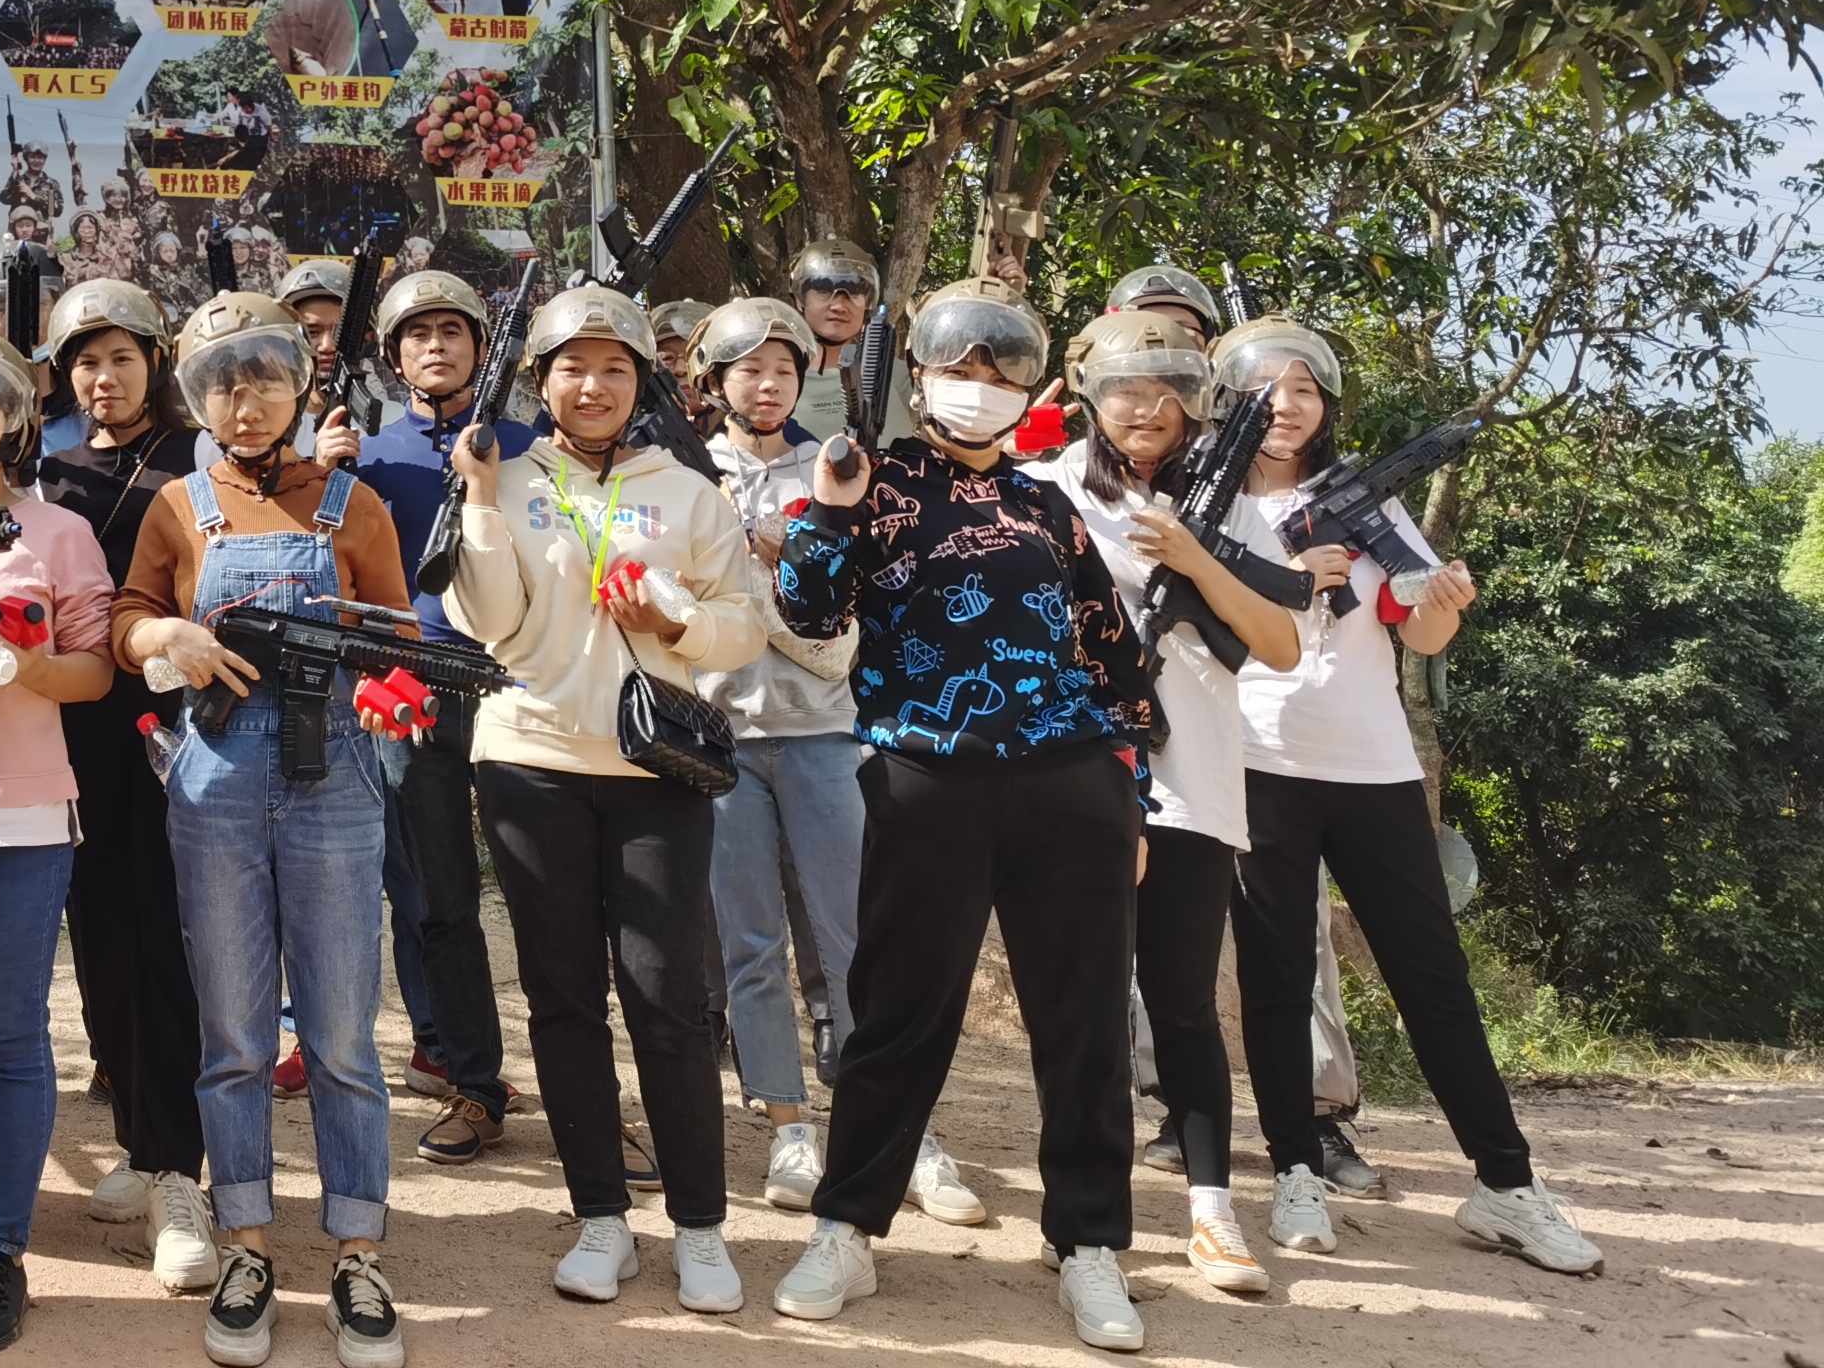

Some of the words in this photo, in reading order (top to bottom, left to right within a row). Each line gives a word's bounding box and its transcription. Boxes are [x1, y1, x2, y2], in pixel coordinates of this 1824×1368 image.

[167, 10, 249, 31] 团队拓展
[449, 17, 528, 40] 蒙古射箭
[22, 73, 106, 95] 真人CS
[299, 80, 381, 102] 户外垂钓
[160, 173, 240, 195] 野炊烧烤
[447, 181, 531, 203] 水果采摘
[992, 637, 1058, 670] Sweet
